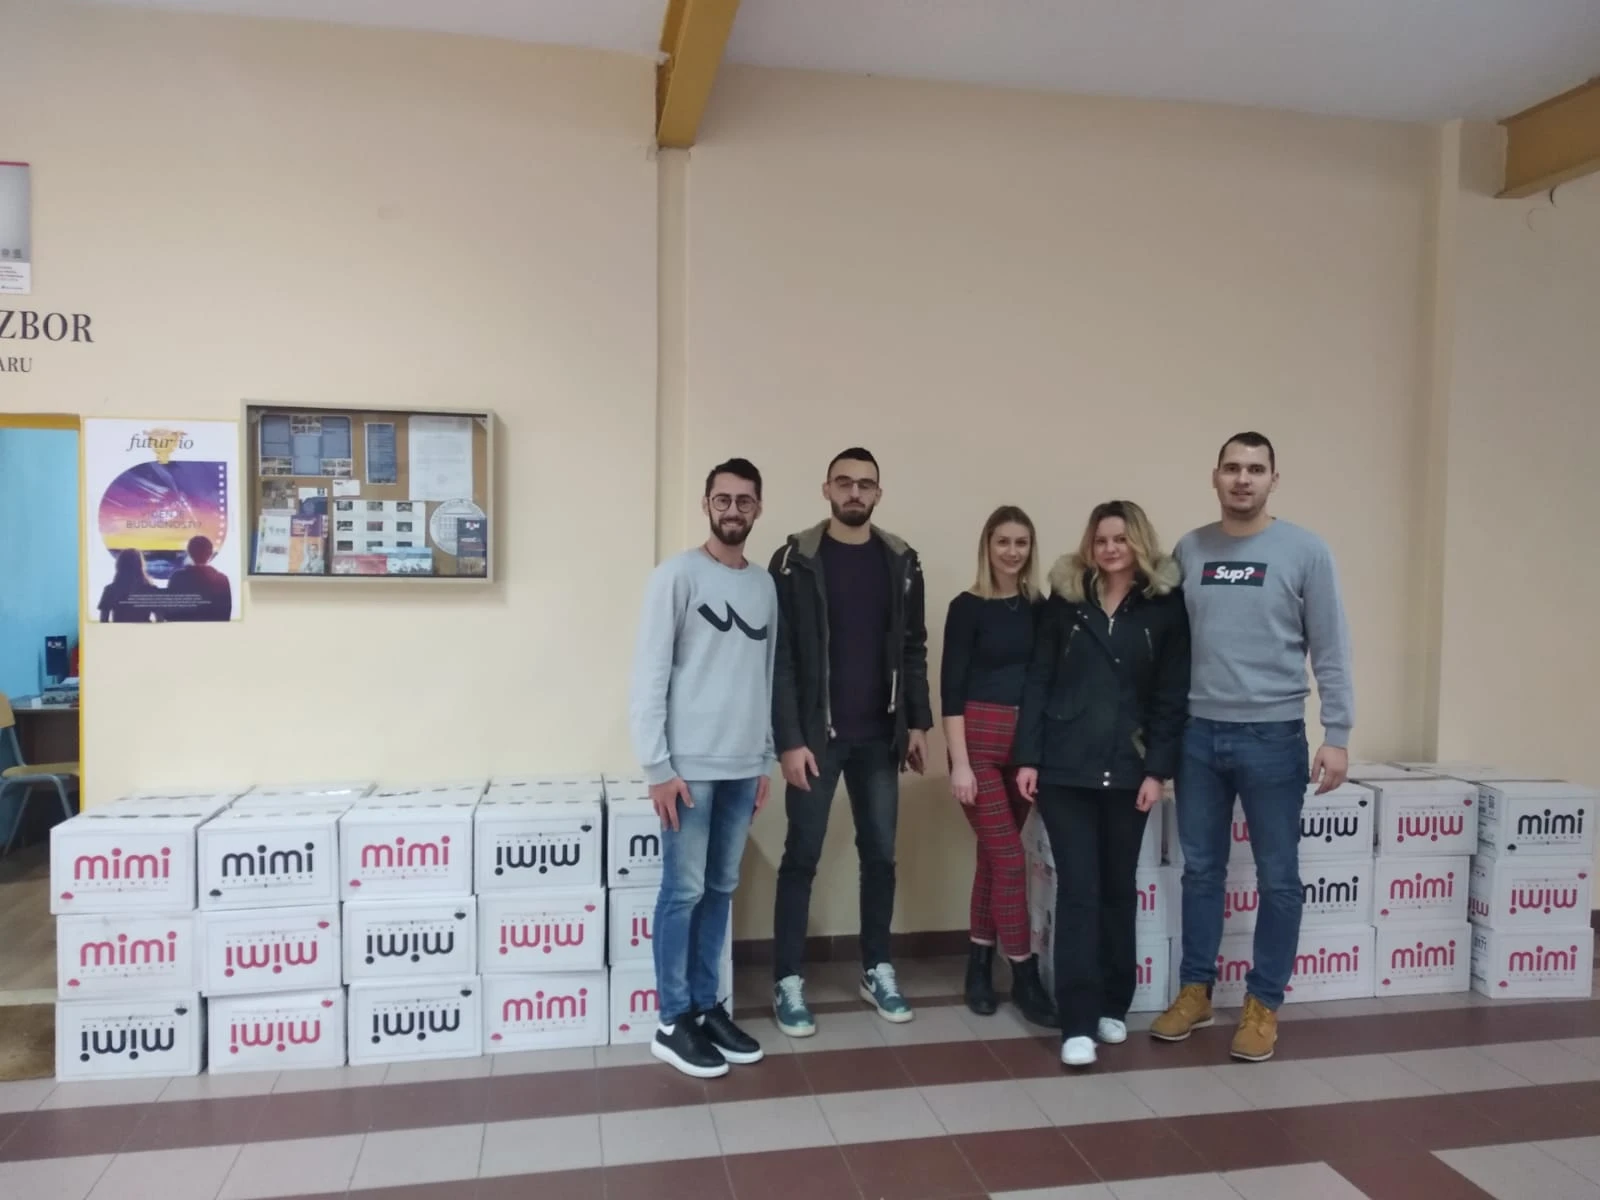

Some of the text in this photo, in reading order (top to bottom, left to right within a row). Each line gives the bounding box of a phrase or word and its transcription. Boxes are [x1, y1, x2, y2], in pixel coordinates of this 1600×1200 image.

[0, 309, 95, 343] ZBOR
[1213, 566, 1255, 583] Sup?
[1301, 815, 1359, 843] mim
[1396, 814, 1464, 843] mimi
[1516, 808, 1585, 836] mimi
[74, 846, 171, 880] mimi
[221, 841, 315, 878] mimi
[361, 835, 450, 868] mimi
[494, 843, 581, 877] mimi
[1389, 871, 1454, 900] mimi
[1509, 888, 1578, 916] mimi
[80, 930, 177, 968] mimi
[364, 930, 455, 965] mimi
[498, 922, 585, 956] mimi
[1391, 939, 1456, 969] mimi
[223, 940, 318, 978] mimi
[1216, 954, 1251, 983] im
[1508, 944, 1578, 973] mimi
[502, 987, 588, 1023] mimi
[228, 1020, 321, 1055] mimi
[371, 1008, 461, 1045] mimi
[79, 1026, 176, 1063] mimi
